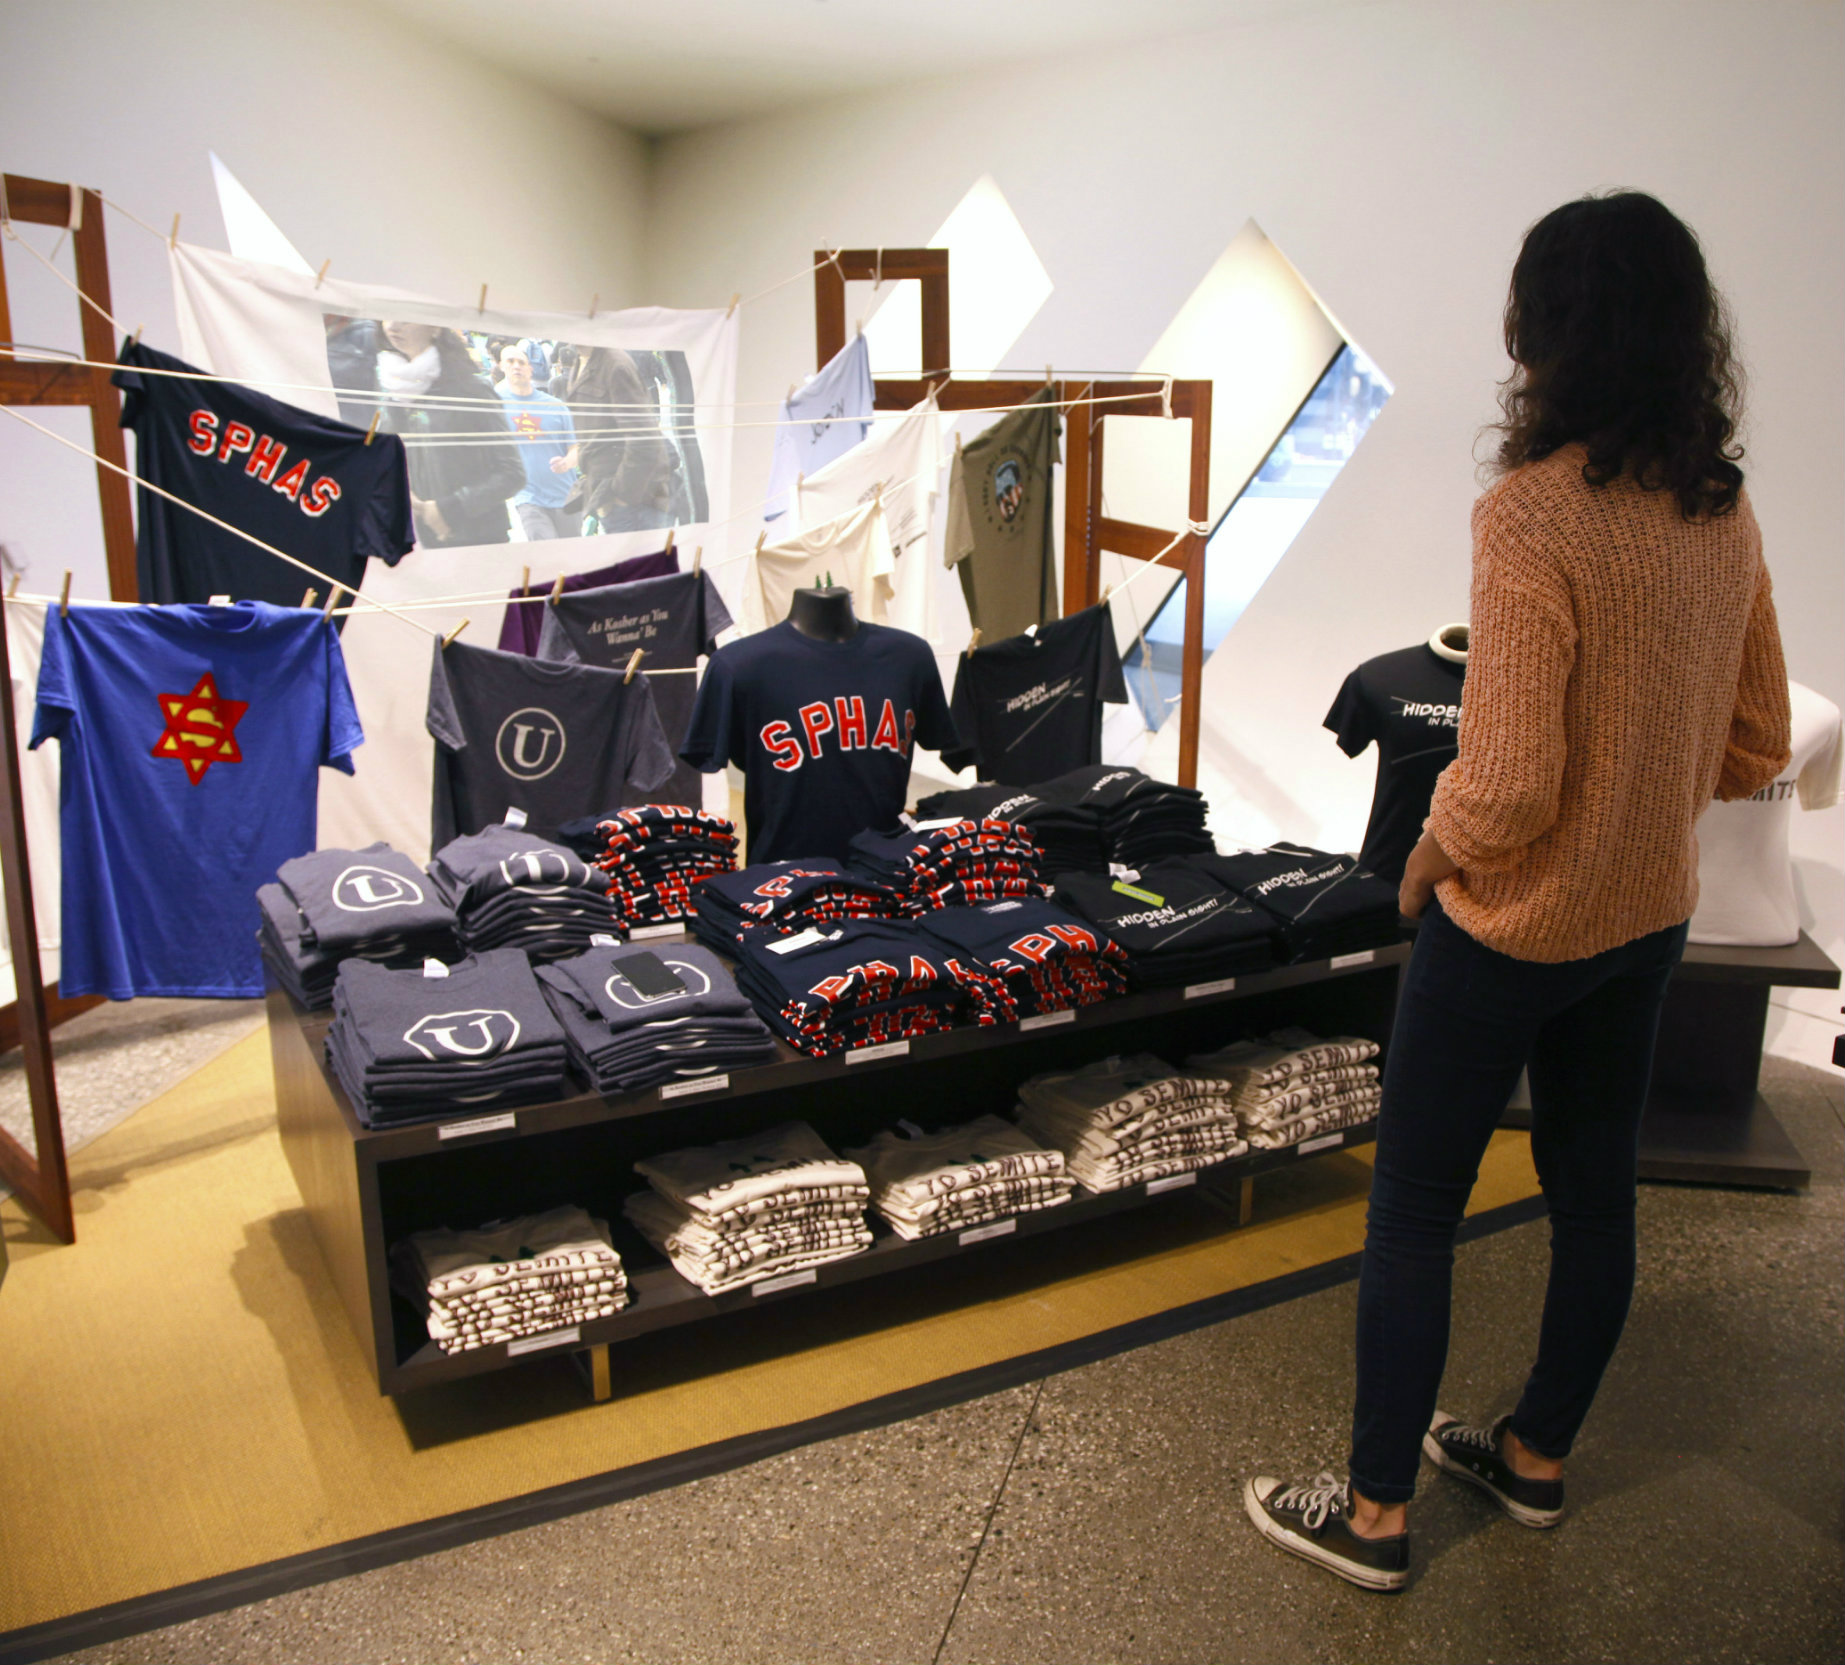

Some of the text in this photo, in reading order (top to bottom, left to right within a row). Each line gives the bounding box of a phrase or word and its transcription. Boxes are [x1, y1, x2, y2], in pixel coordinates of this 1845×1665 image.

[187, 409, 342, 518] SPHAS
[604, 615, 638, 631] Kosher
[651, 608, 669, 622] You
[1006, 681, 1047, 713] HIDDEN
[760, 695, 916, 772] SPHAS
[1428, 717, 1441, 726] IN
[1257, 867, 1308, 896] HIDDEN
[1117, 904, 1176, 928] HIDDEN
[1137, 1079, 1228, 1107] SEMITE
[965, 1152, 1060, 1184] SEMITE
